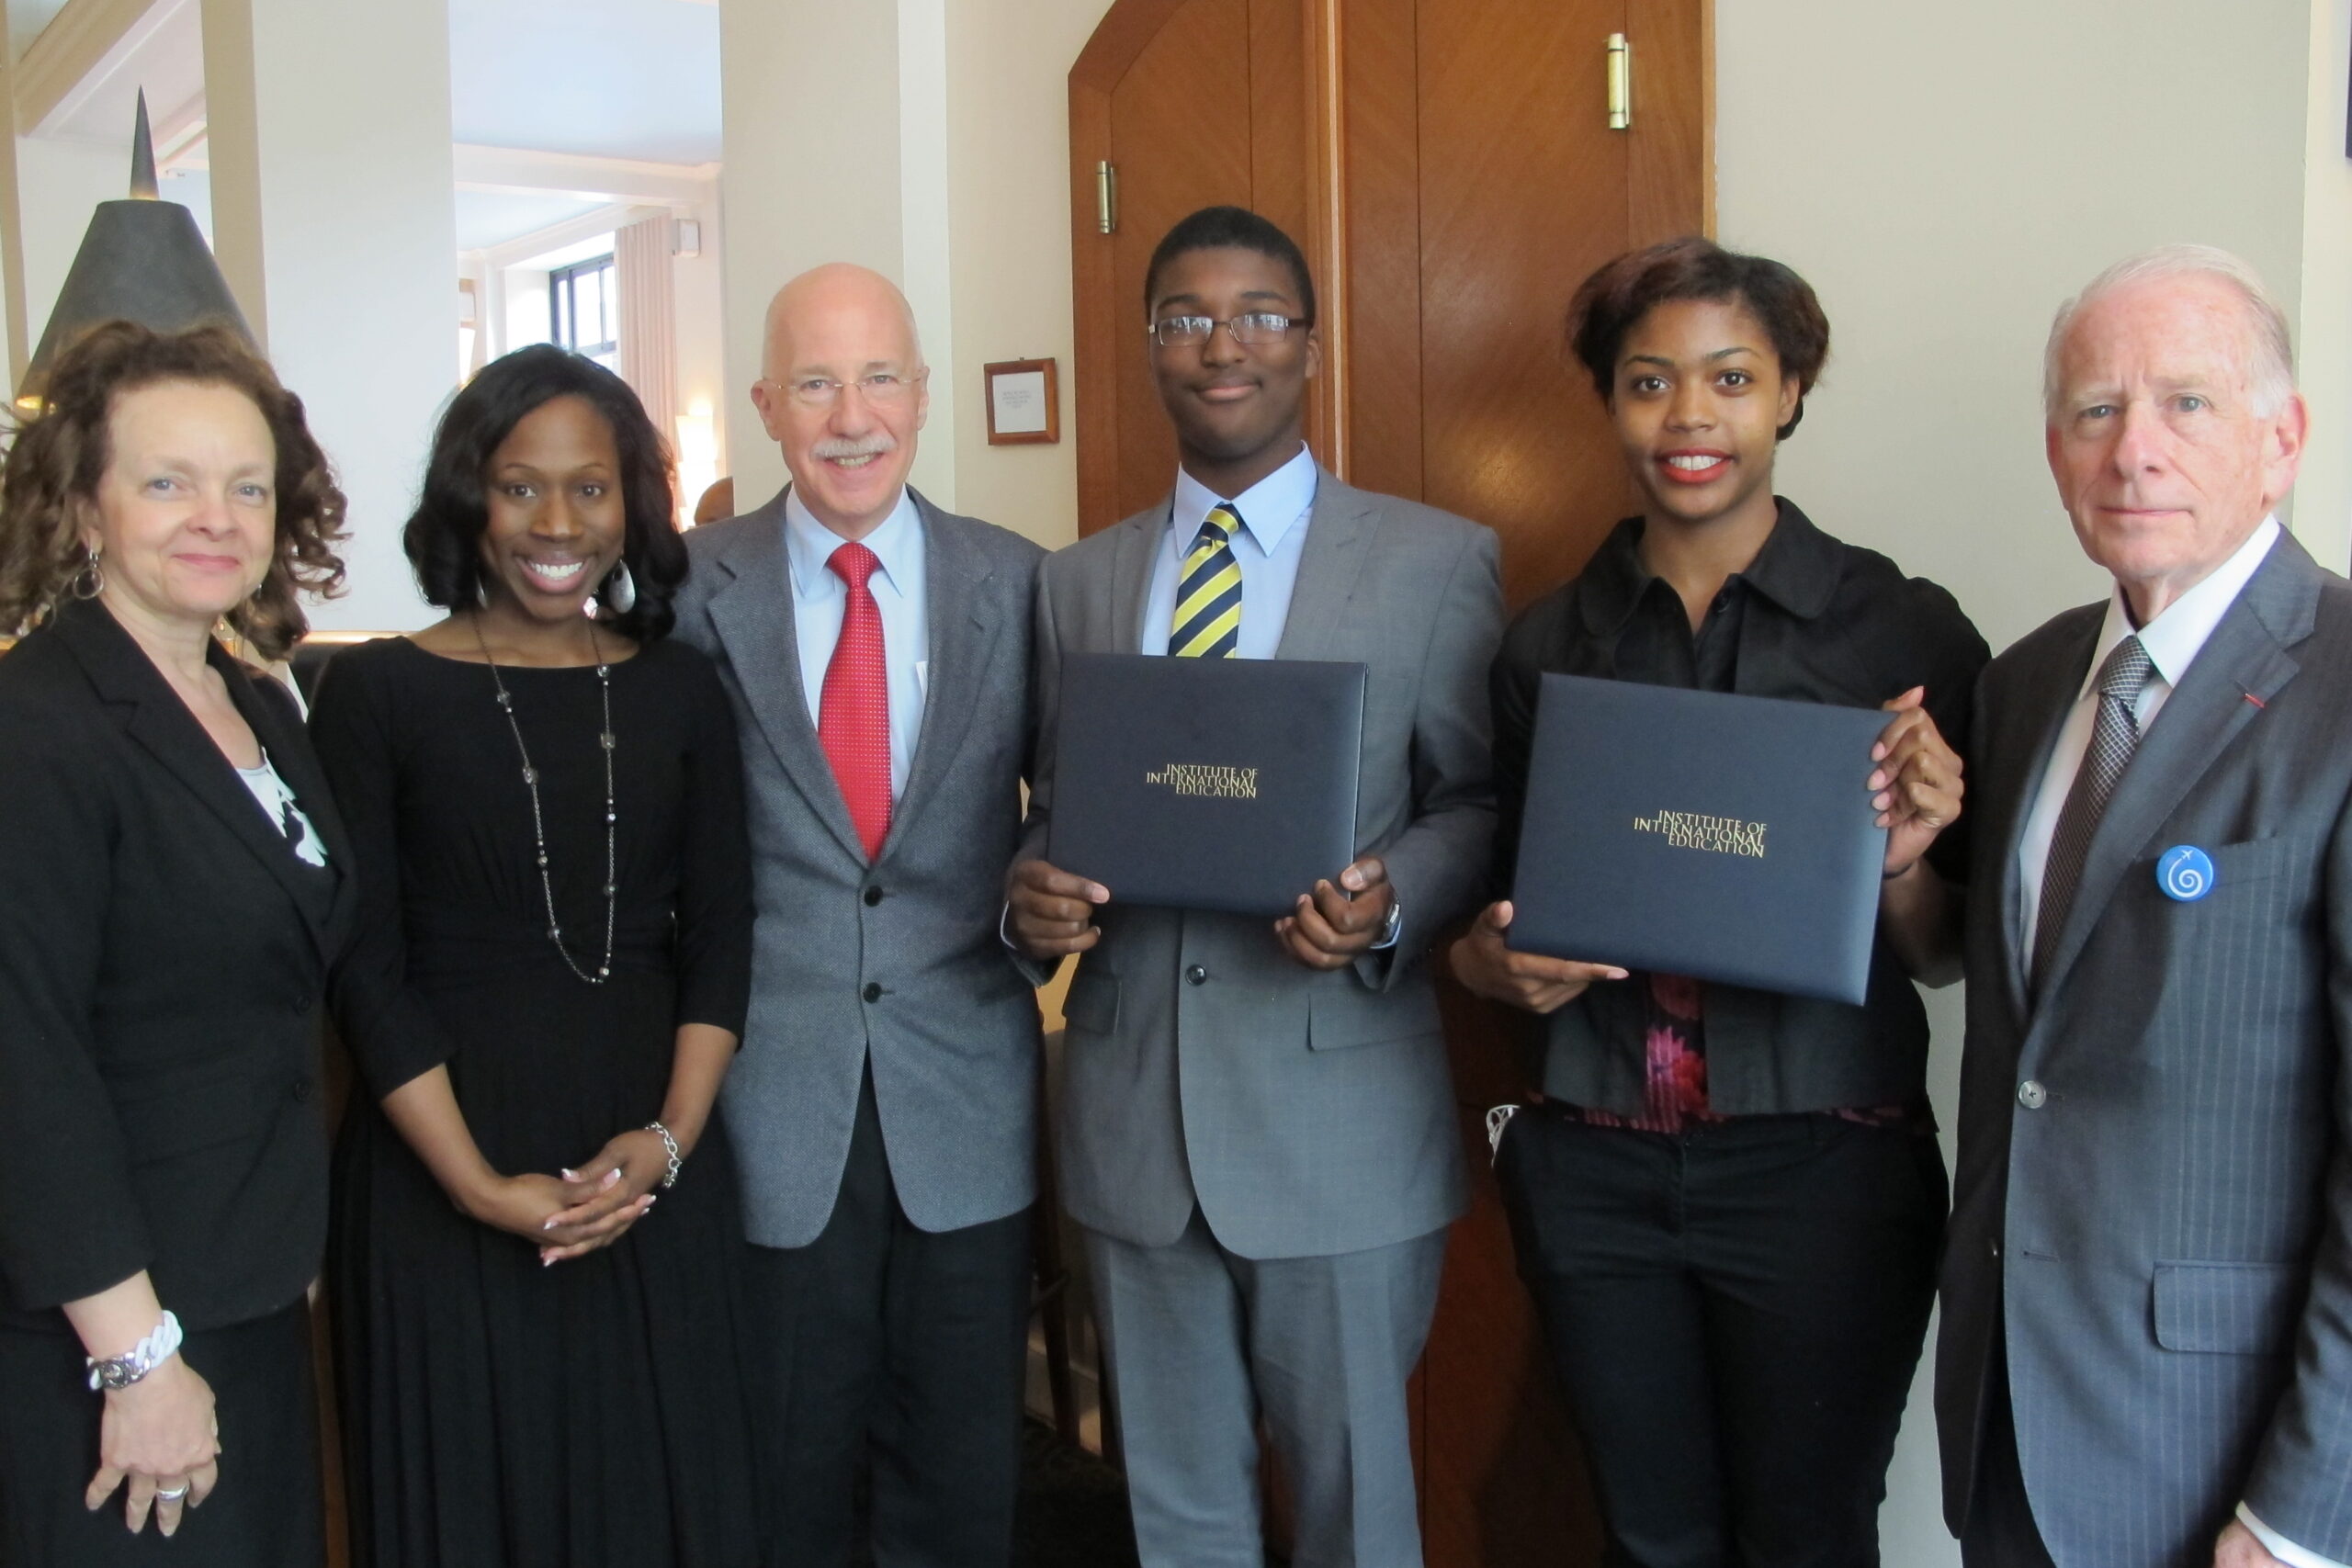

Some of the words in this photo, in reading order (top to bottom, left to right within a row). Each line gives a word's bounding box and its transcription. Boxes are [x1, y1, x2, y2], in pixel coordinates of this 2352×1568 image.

[1147, 772, 1255, 788] INTERNATIONAL
[1166, 763, 1237, 779] INSTITUTE
[1240, 768, 1258, 780] OF
[1175, 784, 1257, 798] EDUCATION
[1634, 817, 1764, 846] INTERNATIONAL
[1658, 809, 1742, 833] INSTITUTE
[1747, 822, 1768, 835] OF
[1668, 833, 1765, 858] EDUCATION
